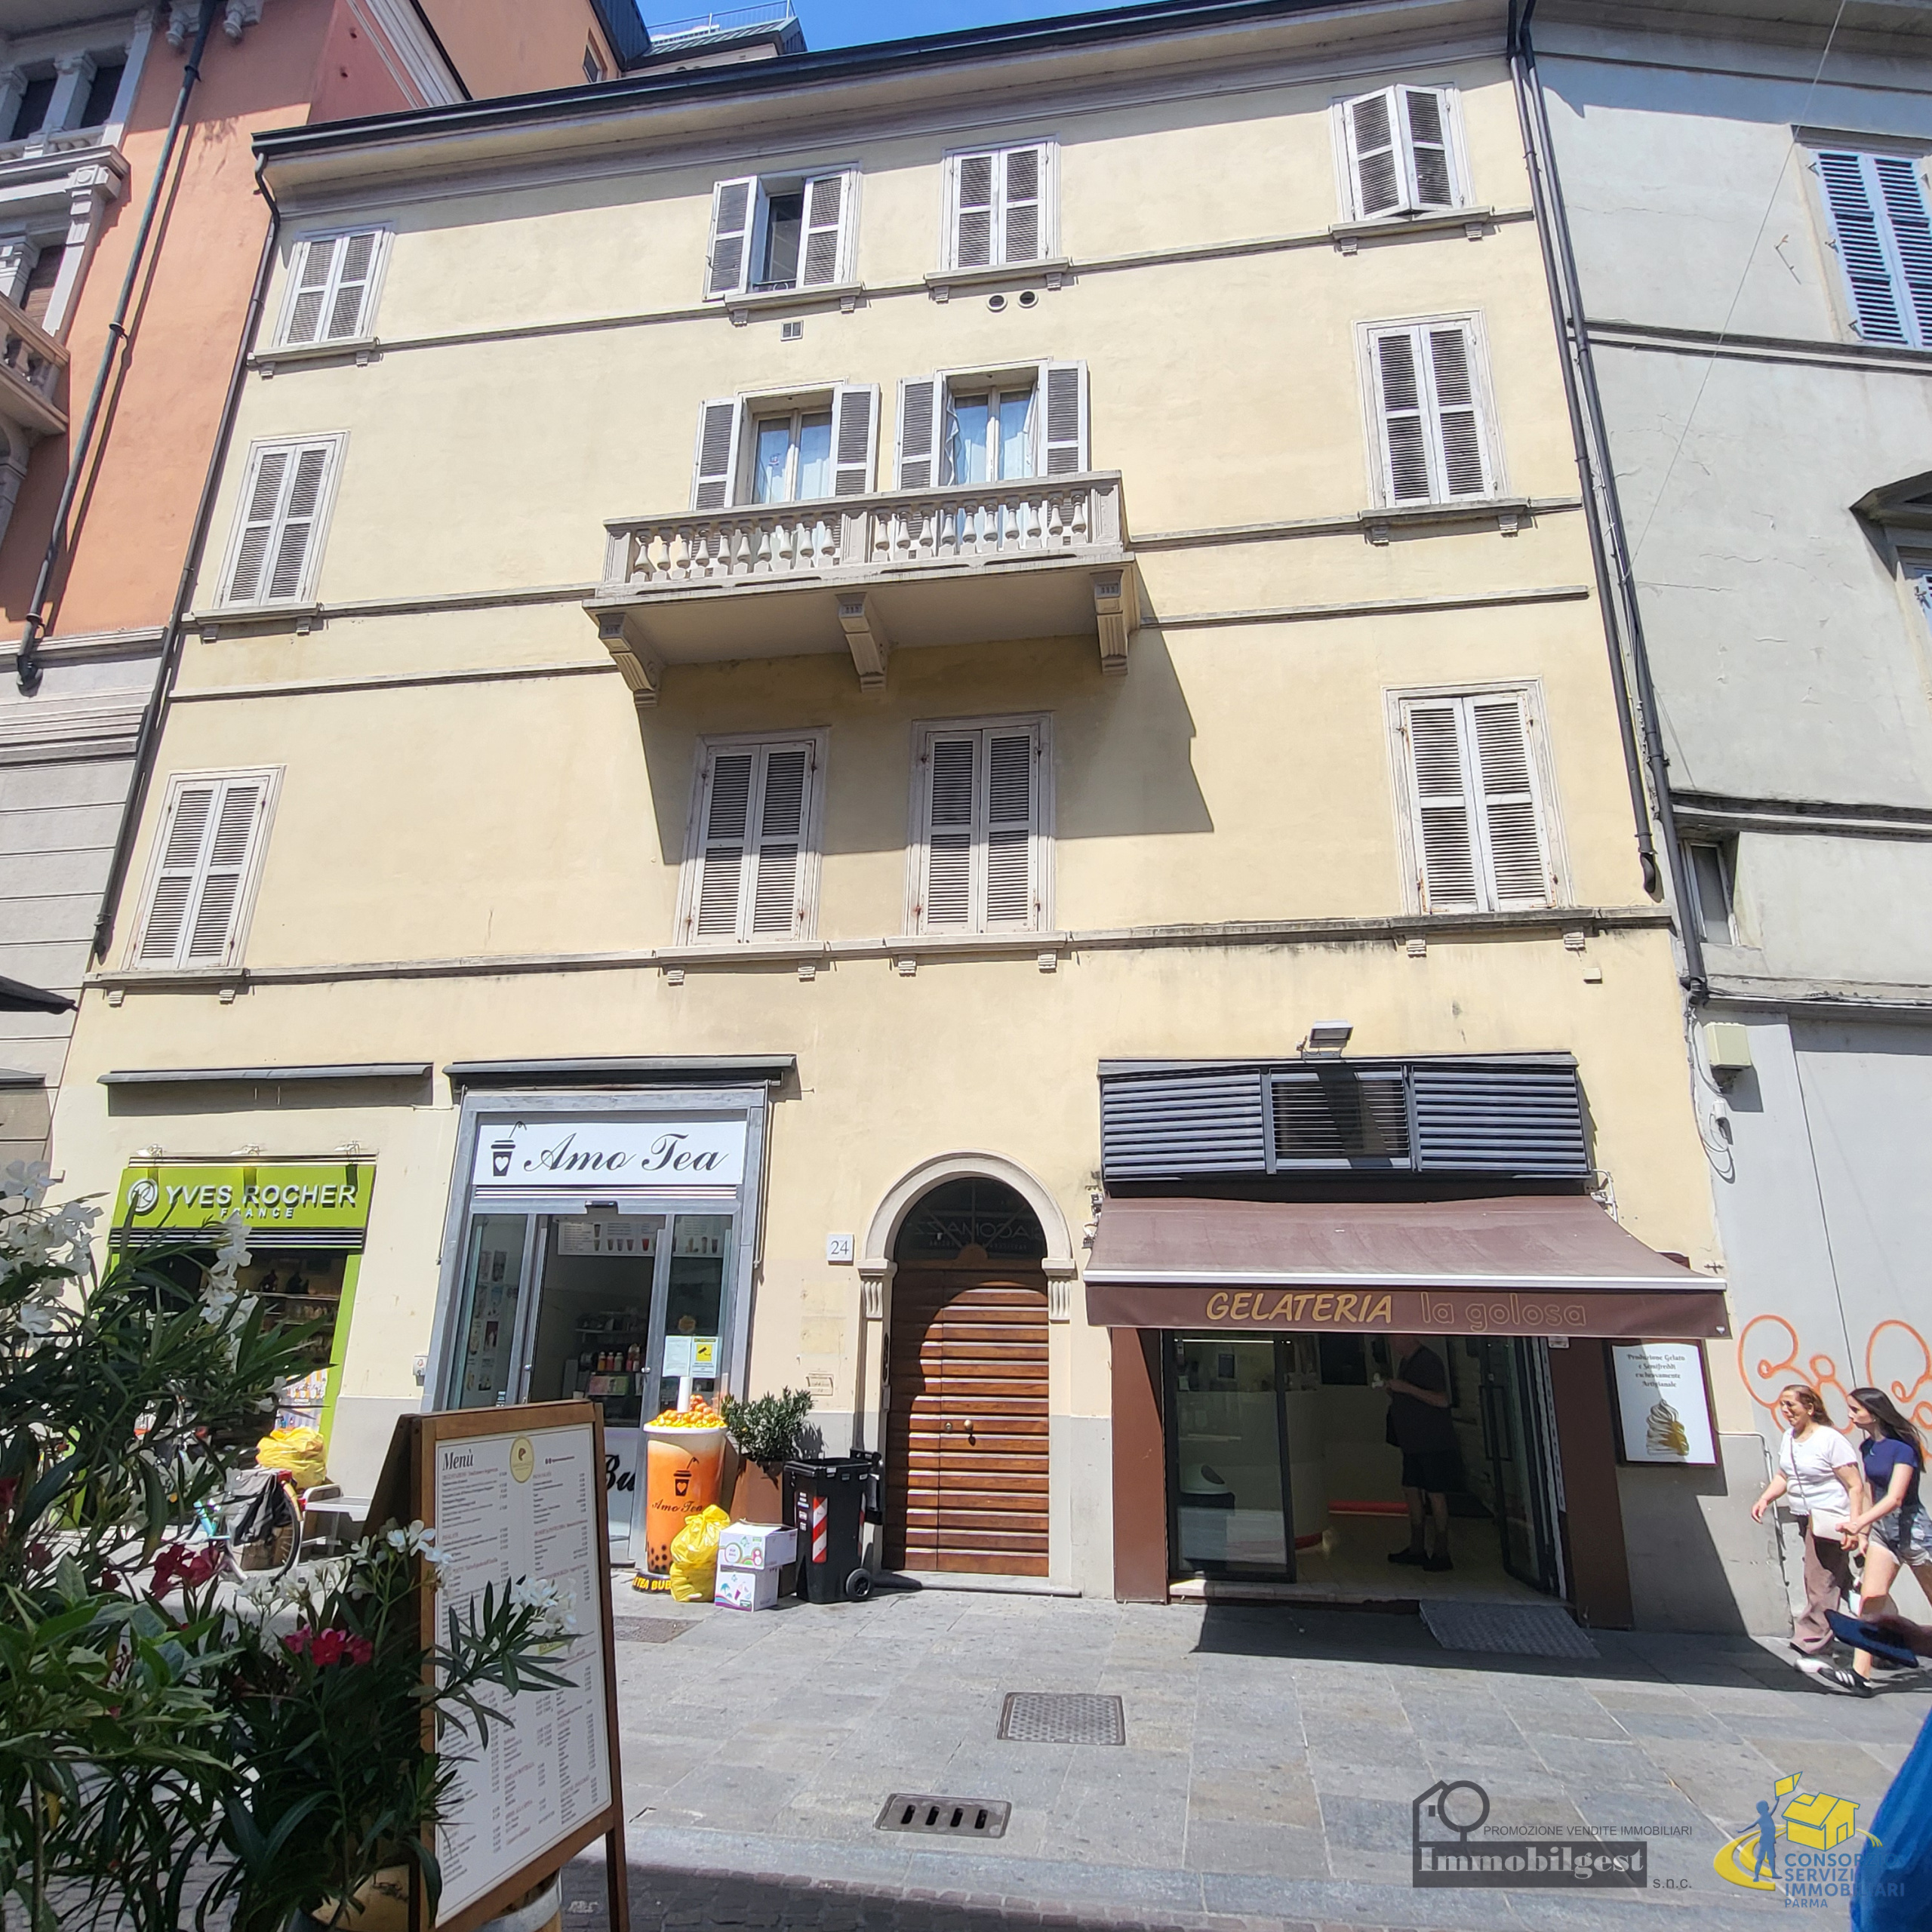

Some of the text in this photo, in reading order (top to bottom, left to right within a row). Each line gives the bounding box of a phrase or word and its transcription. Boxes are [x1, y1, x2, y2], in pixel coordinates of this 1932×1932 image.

[524, 1133, 729, 1171] Amo Tea
[165, 1185, 356, 1208] YVES ROCHER
[830, 1240, 850, 1255] 24
[1207, 1291, 1586, 1333] GELATERIA la golosa
[1664, 1354, 1685, 1362] Gelato
[442, 1448, 473, 1471] Menù
[652, 1499, 703, 1512] Amo Tea
